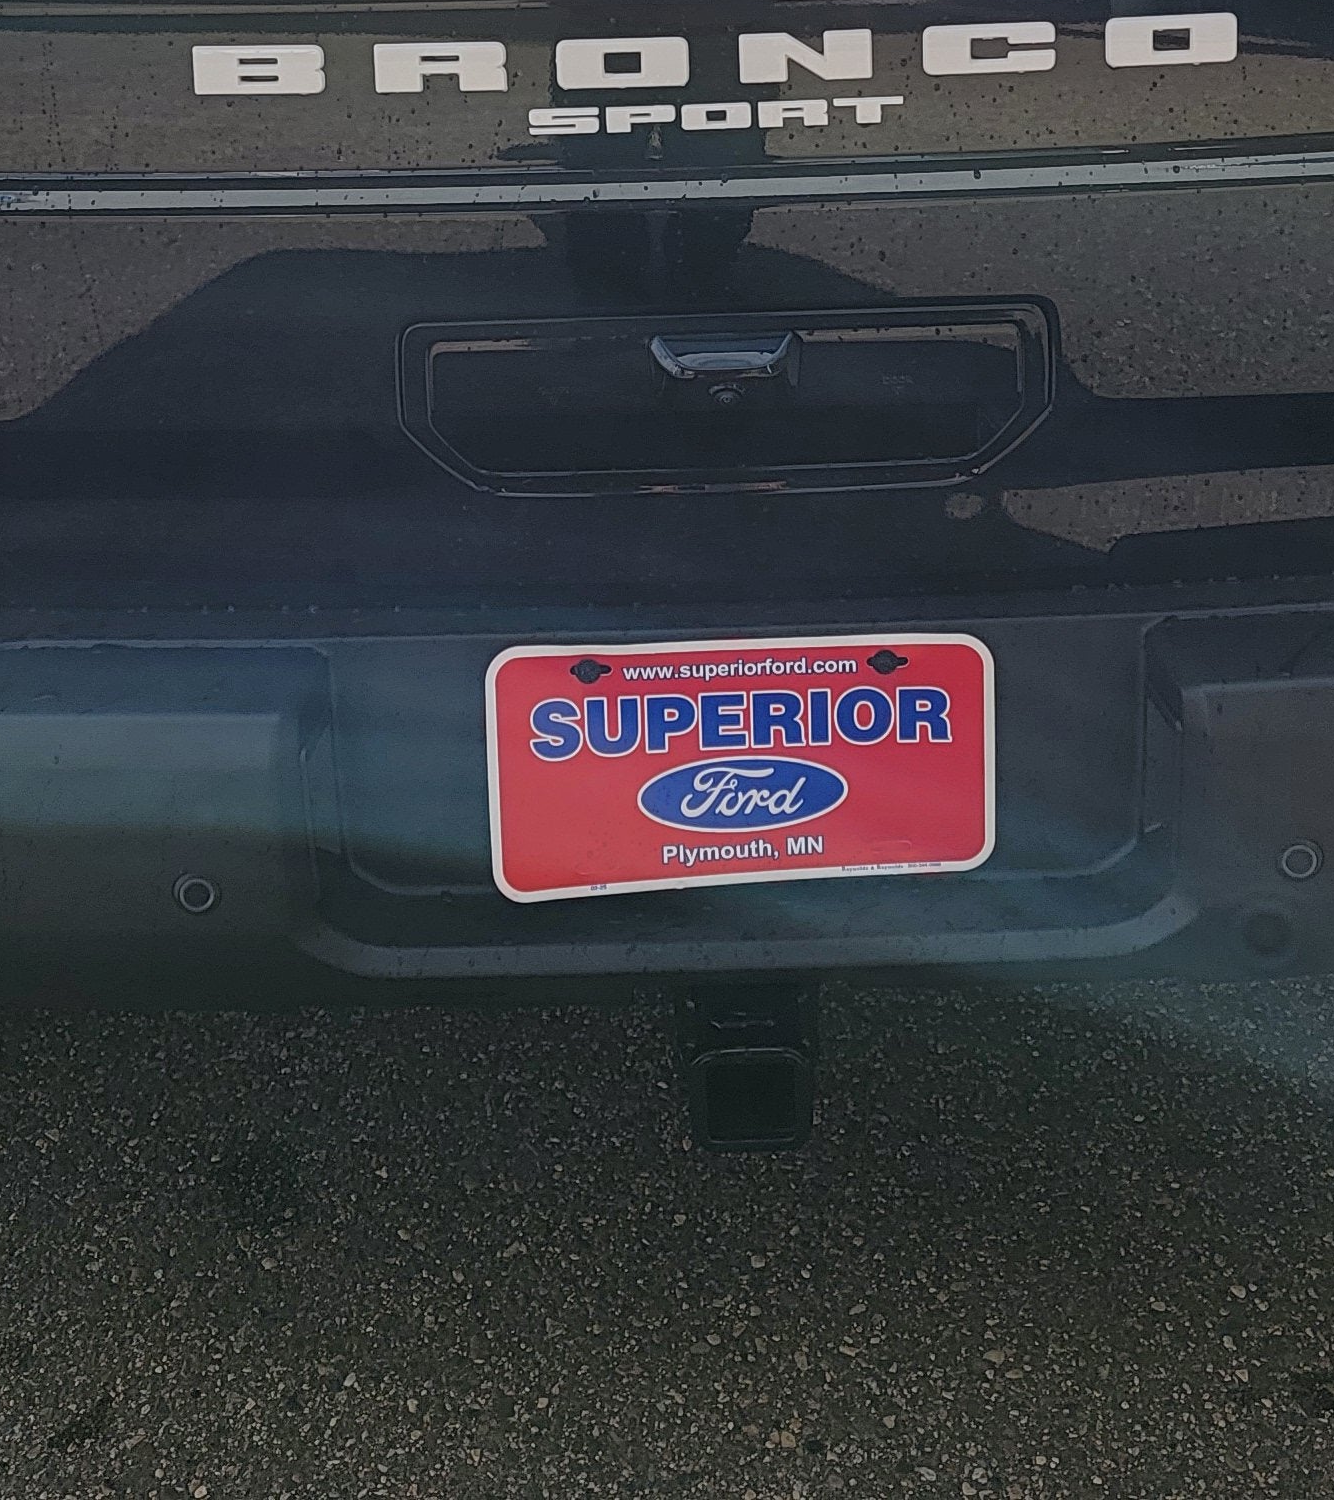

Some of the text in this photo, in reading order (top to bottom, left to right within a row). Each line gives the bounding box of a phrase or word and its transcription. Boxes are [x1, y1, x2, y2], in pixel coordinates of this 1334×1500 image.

[192, 12, 1238, 96] BRONCO
[527, 96, 904, 136] SPORT
[622, 655, 858, 681] www.superiorford.com
[529, 686, 953, 761] SUPERIOR
[679, 766, 805, 819] Ford
[662, 835, 824, 866] Plymouth, MN
